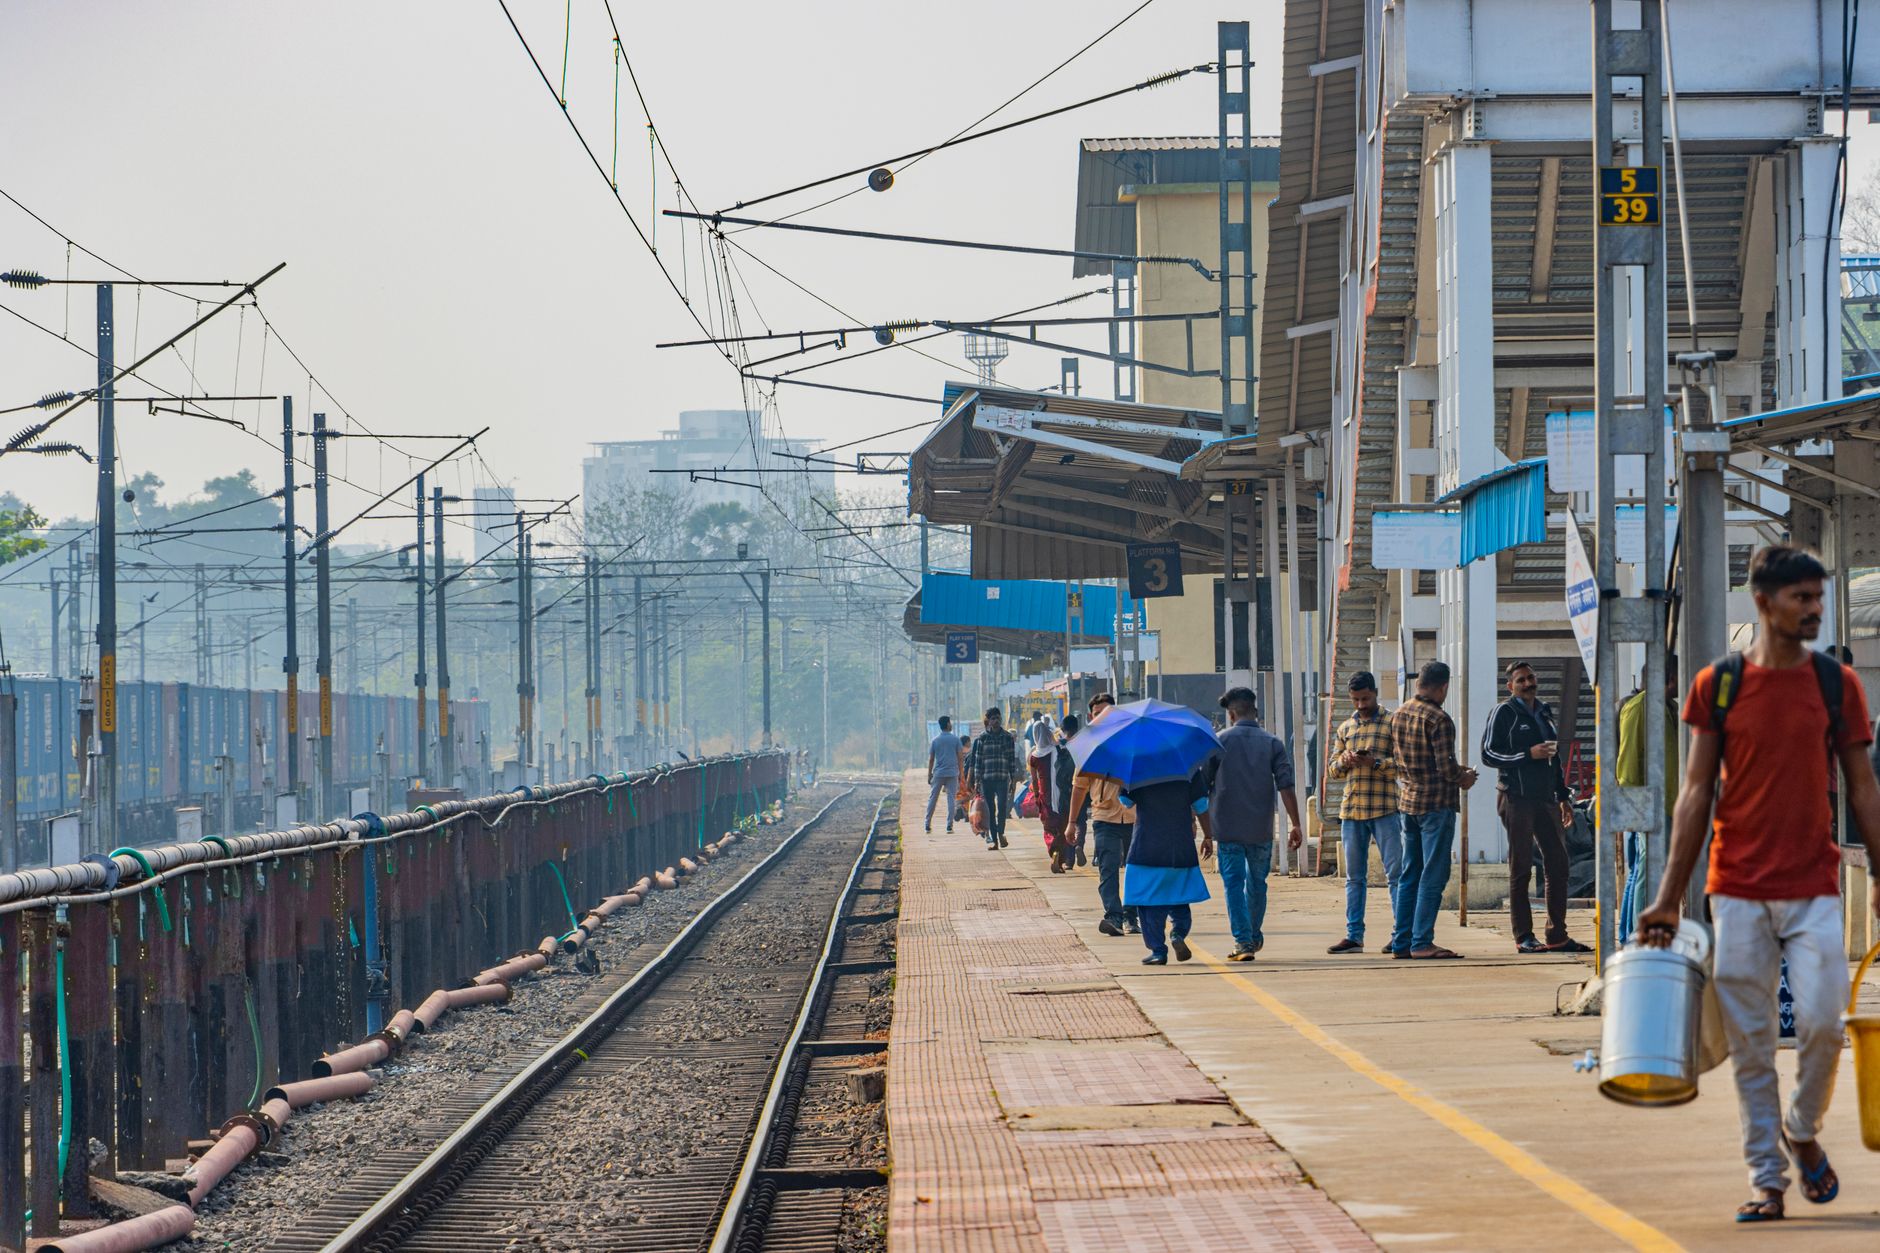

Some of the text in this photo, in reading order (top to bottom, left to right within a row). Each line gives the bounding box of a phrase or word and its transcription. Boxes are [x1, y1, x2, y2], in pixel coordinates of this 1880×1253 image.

[1621, 169, 1636, 193] 5
[1613, 198, 1648, 223] 39
[1232, 482, 1247, 495] 37
[1128, 546, 1164, 557] PLATFORM
[1144, 558, 1168, 592] 3
[955, 642, 968, 659] 3
